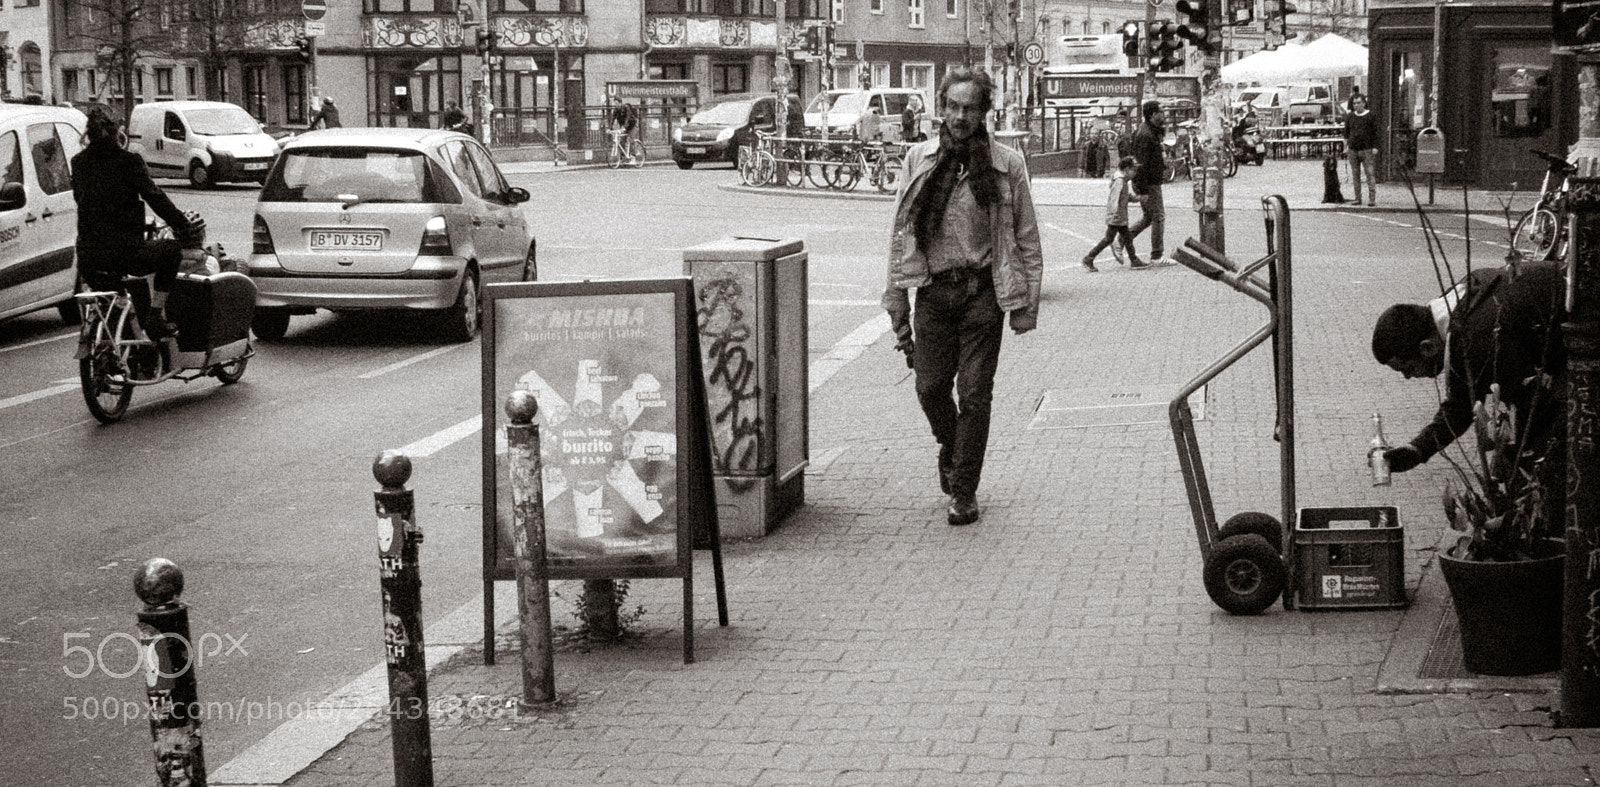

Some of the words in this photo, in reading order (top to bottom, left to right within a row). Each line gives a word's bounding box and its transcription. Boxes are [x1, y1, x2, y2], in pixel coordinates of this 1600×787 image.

[1028, 48, 1040, 60] 30
[608, 84, 617, 96] U
[621, 85, 689, 96] Weinmeisterstraße
[1047, 80, 1060, 95] U
[318, 234, 326, 246] B
[334, 234, 349, 246] DV
[351, 234, 380, 246] 3157
[562, 439, 614, 454] burrito
